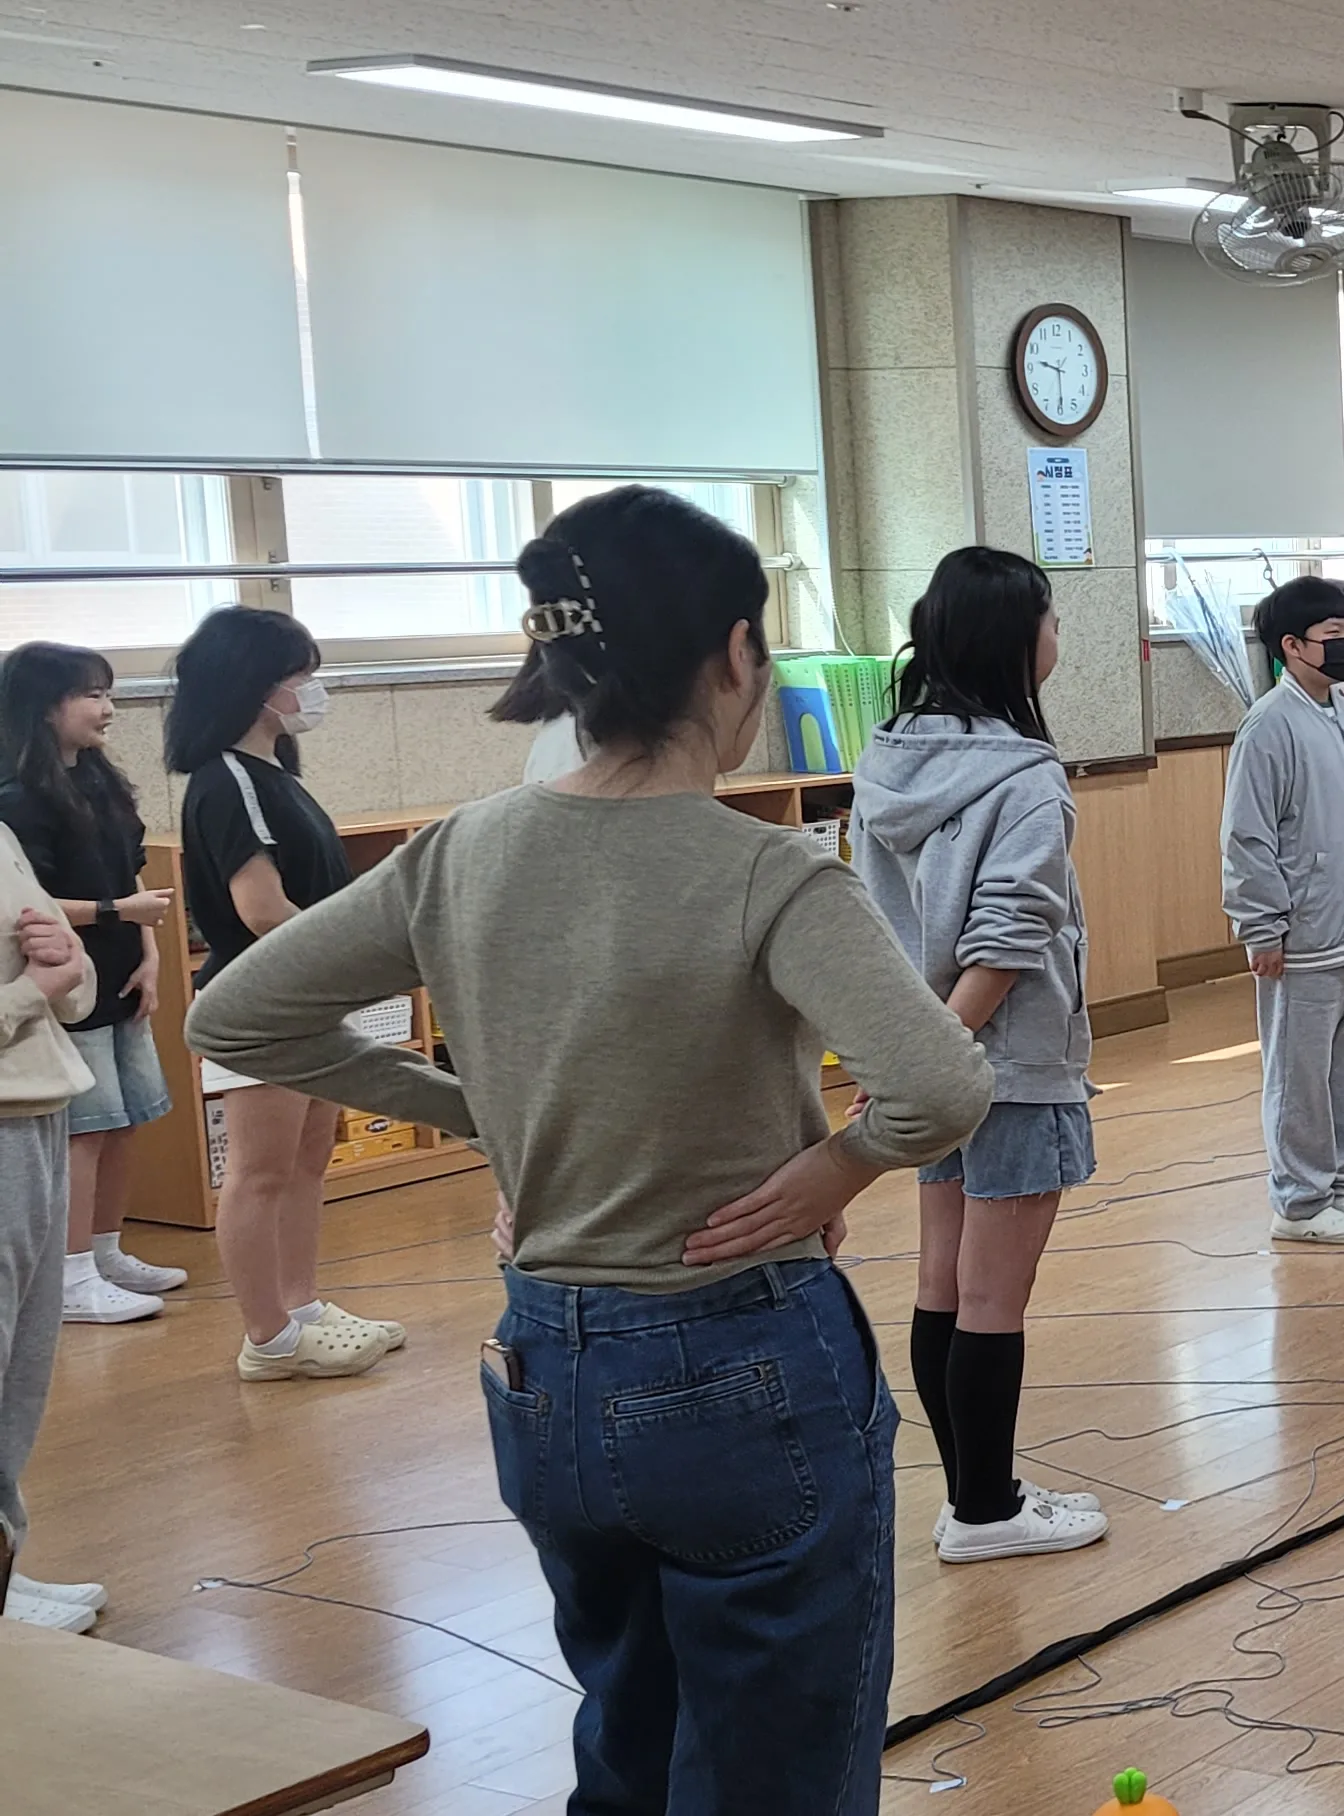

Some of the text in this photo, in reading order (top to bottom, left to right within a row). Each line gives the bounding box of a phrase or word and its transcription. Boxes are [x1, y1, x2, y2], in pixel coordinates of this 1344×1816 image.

[1040, 327, 1047, 340] 11
[1052, 324, 1061, 336] 12
[1029, 342, 1039, 355] 10
[1077, 344, 1083, 356] 2
[1027, 362, 1034, 375] 9
[1081, 364, 1088, 377] 3
[1032, 382, 1039, 396] 8
[1078, 384, 1085, 396] 4
[1043, 398, 1049, 411] 7
[1057, 403, 1064, 415] 6
[1070, 398, 1078, 411] 5
